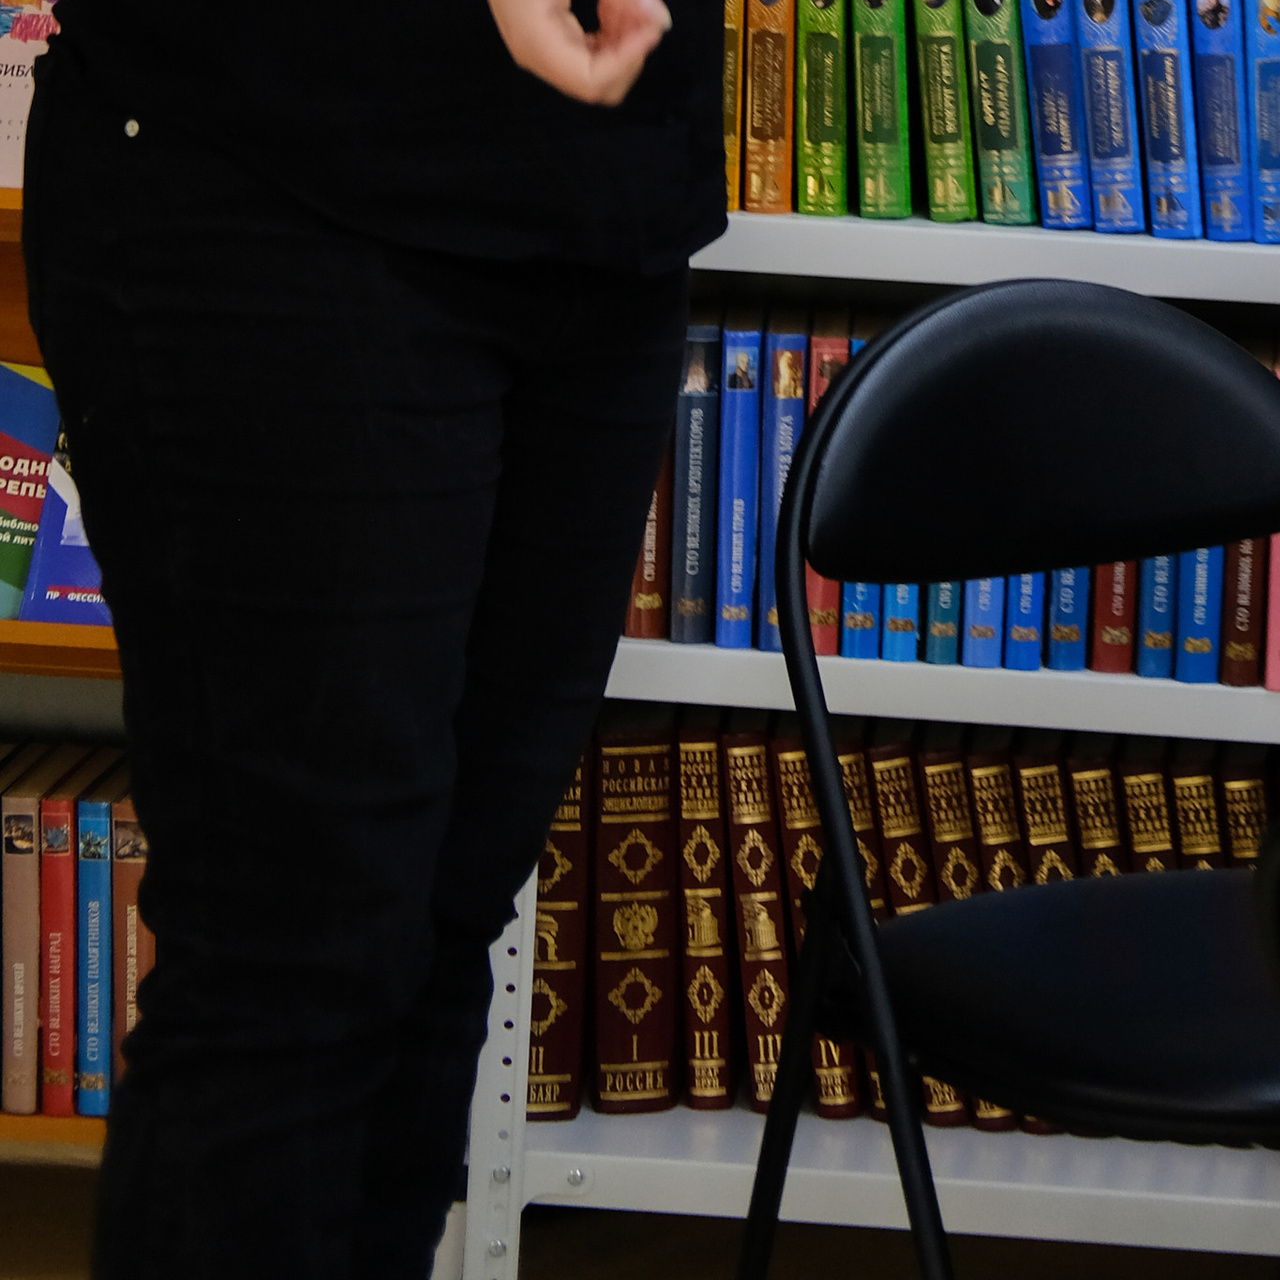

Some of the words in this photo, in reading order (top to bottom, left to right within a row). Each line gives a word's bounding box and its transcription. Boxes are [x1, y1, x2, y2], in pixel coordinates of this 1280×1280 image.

[688, 408, 704, 493] АРХИТЕКТОРОВ
[0, 456, 51, 476] ОДН
[686, 496, 701, 549] ВЕЛИКИХ
[644, 563, 656, 581] СТО
[686, 550, 699, 575] СТО
[731, 575, 742, 593] СТО
[1235, 608, 1250, 632] СТО
[602, 758, 669, 774] НОВАЯ
[602, 777, 670, 792] РОССИЙСКАЯ
[88, 901, 100, 978] ПАМЯТНИКОВ
[49, 932, 62, 974] НАГРАД
[49, 977, 61, 1029] ВЕЛИКИХ
[87, 983, 99, 1034] ВЕЛИКИХ
[49, 1032, 60, 1056] СТО
[87, 1037, 99, 1061] СТО
[606, 1070, 664, 1091] РОССИЯ
